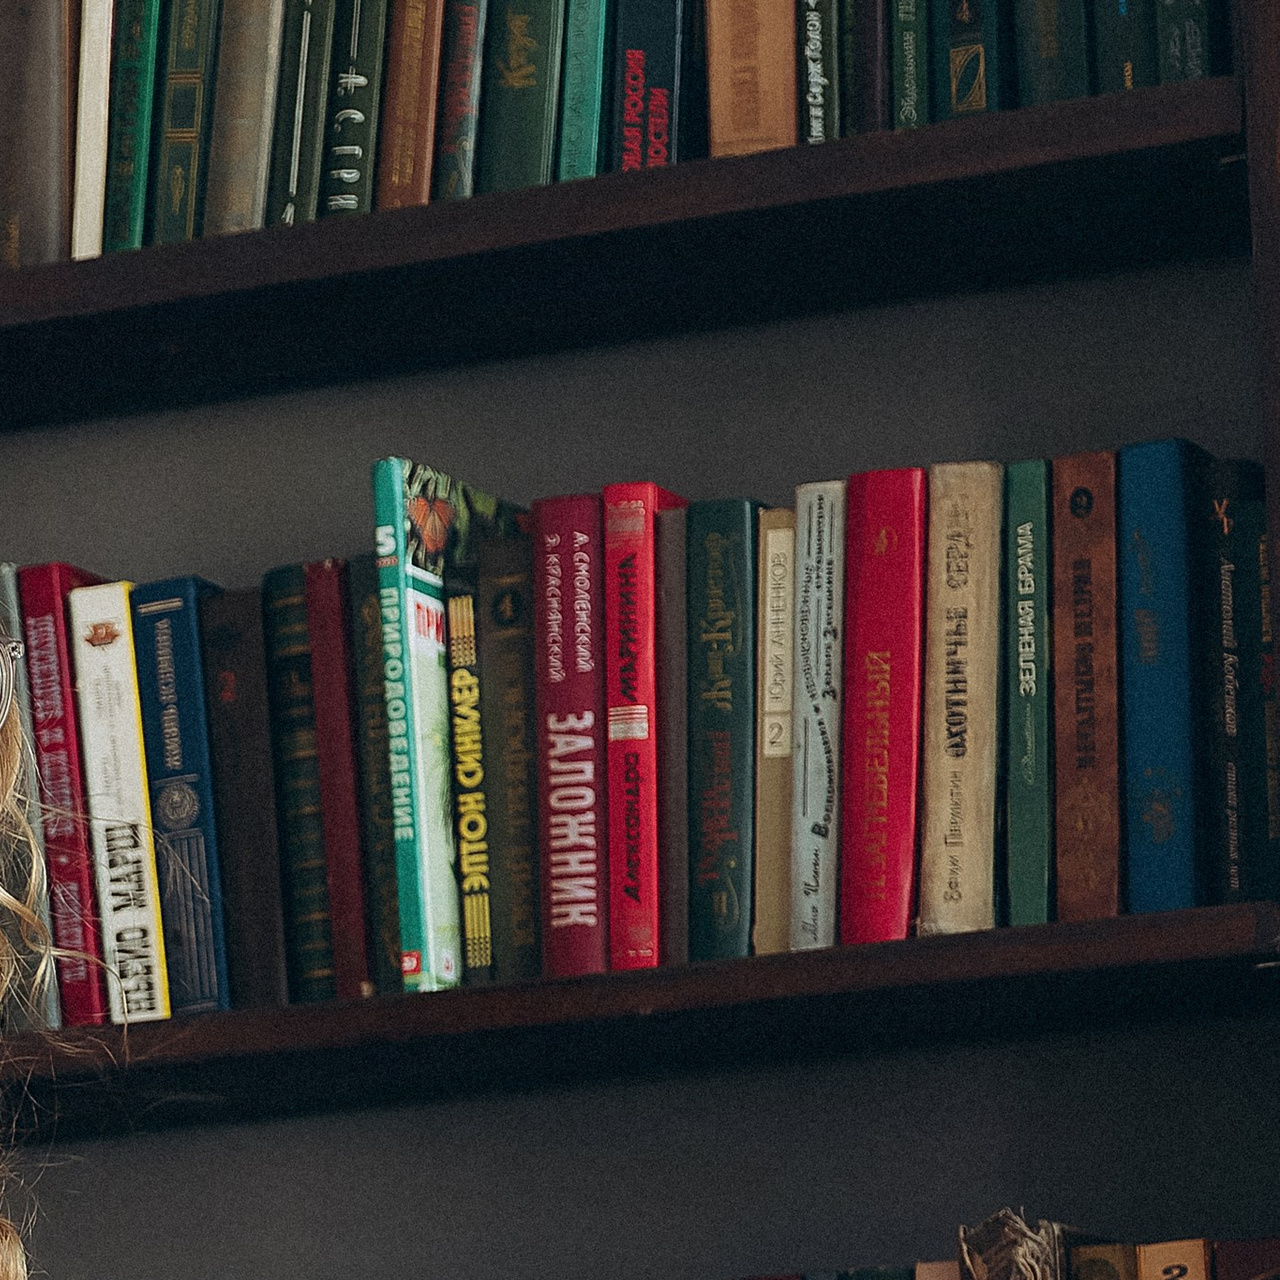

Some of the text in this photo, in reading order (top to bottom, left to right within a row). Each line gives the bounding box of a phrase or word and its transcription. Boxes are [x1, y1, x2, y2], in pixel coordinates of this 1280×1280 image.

[623, 49, 646, 124] РОССИЯ
[574, 550, 595, 673] СМОЛЕНСКИЙ
[769, 552, 787, 649] АННЕНКОВ
[1016, 521, 1036, 595] БРАМА
[944, 606, 969, 759] ОХОТНИЧЬЕ
[1017, 600, 1037, 697] ЗЕЛЕНАЯ
[378, 587, 417, 841] ПРИРОДОВЕДЕНИЕ
[617, 552, 645, 903] Александра МАРИНИНА
[450, 668, 491, 892] ЭПТОН СИНКЛЕР
[546, 709, 597, 927] ЗАЛОЖНИК
[105, 823, 146, 912] МАРШ
